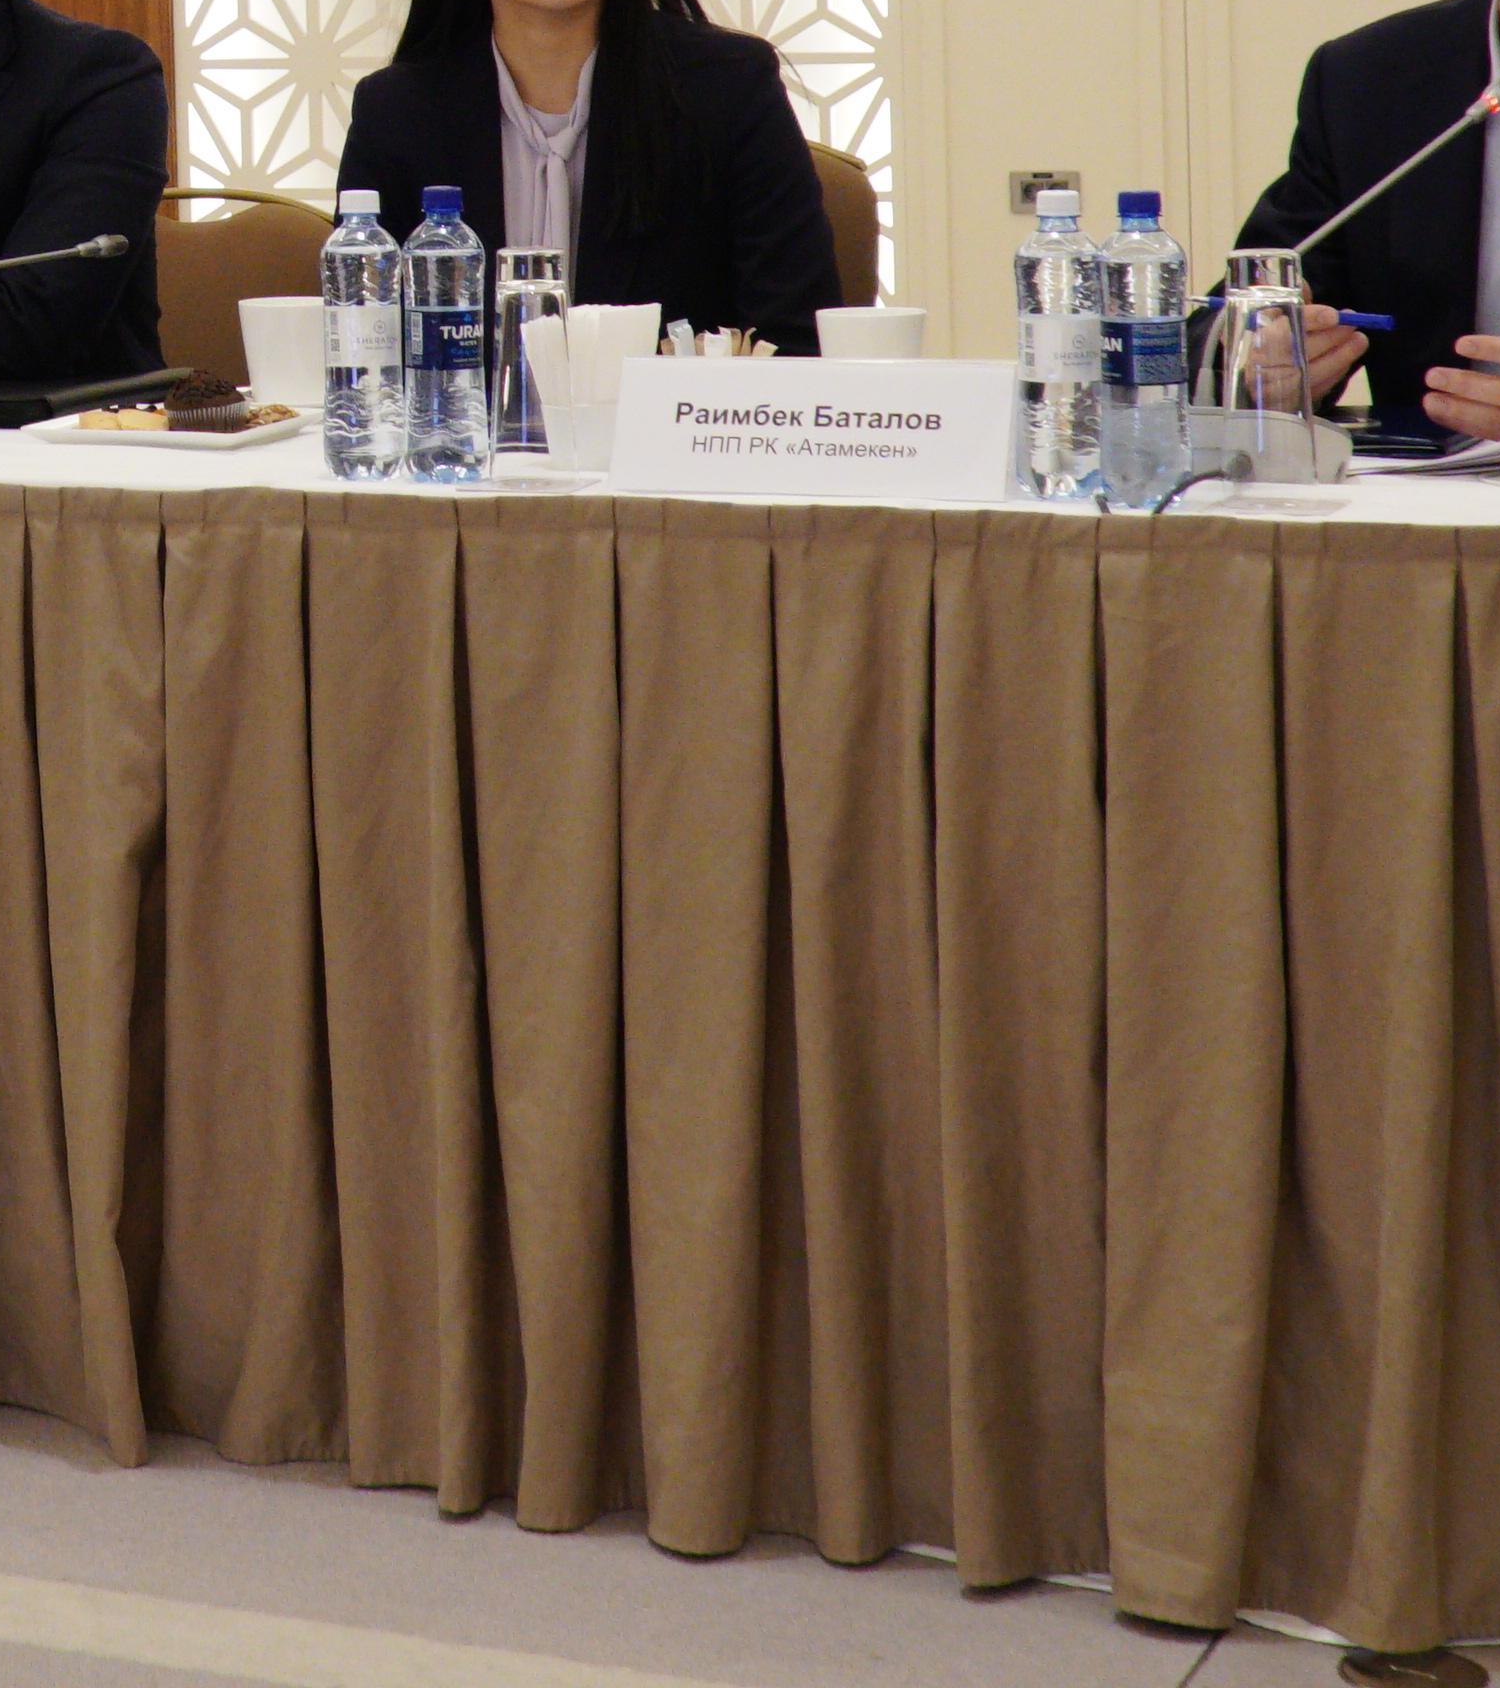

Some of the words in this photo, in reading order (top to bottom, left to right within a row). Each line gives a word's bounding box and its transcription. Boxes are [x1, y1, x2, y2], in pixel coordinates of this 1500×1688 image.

[675, 402, 803, 427] Раимбек
[813, 405, 942, 430] Баталов
[691, 436, 742, 454] НПП
[749, 437, 780, 455] РК
[786, 438, 918, 458] «Атамекен»
